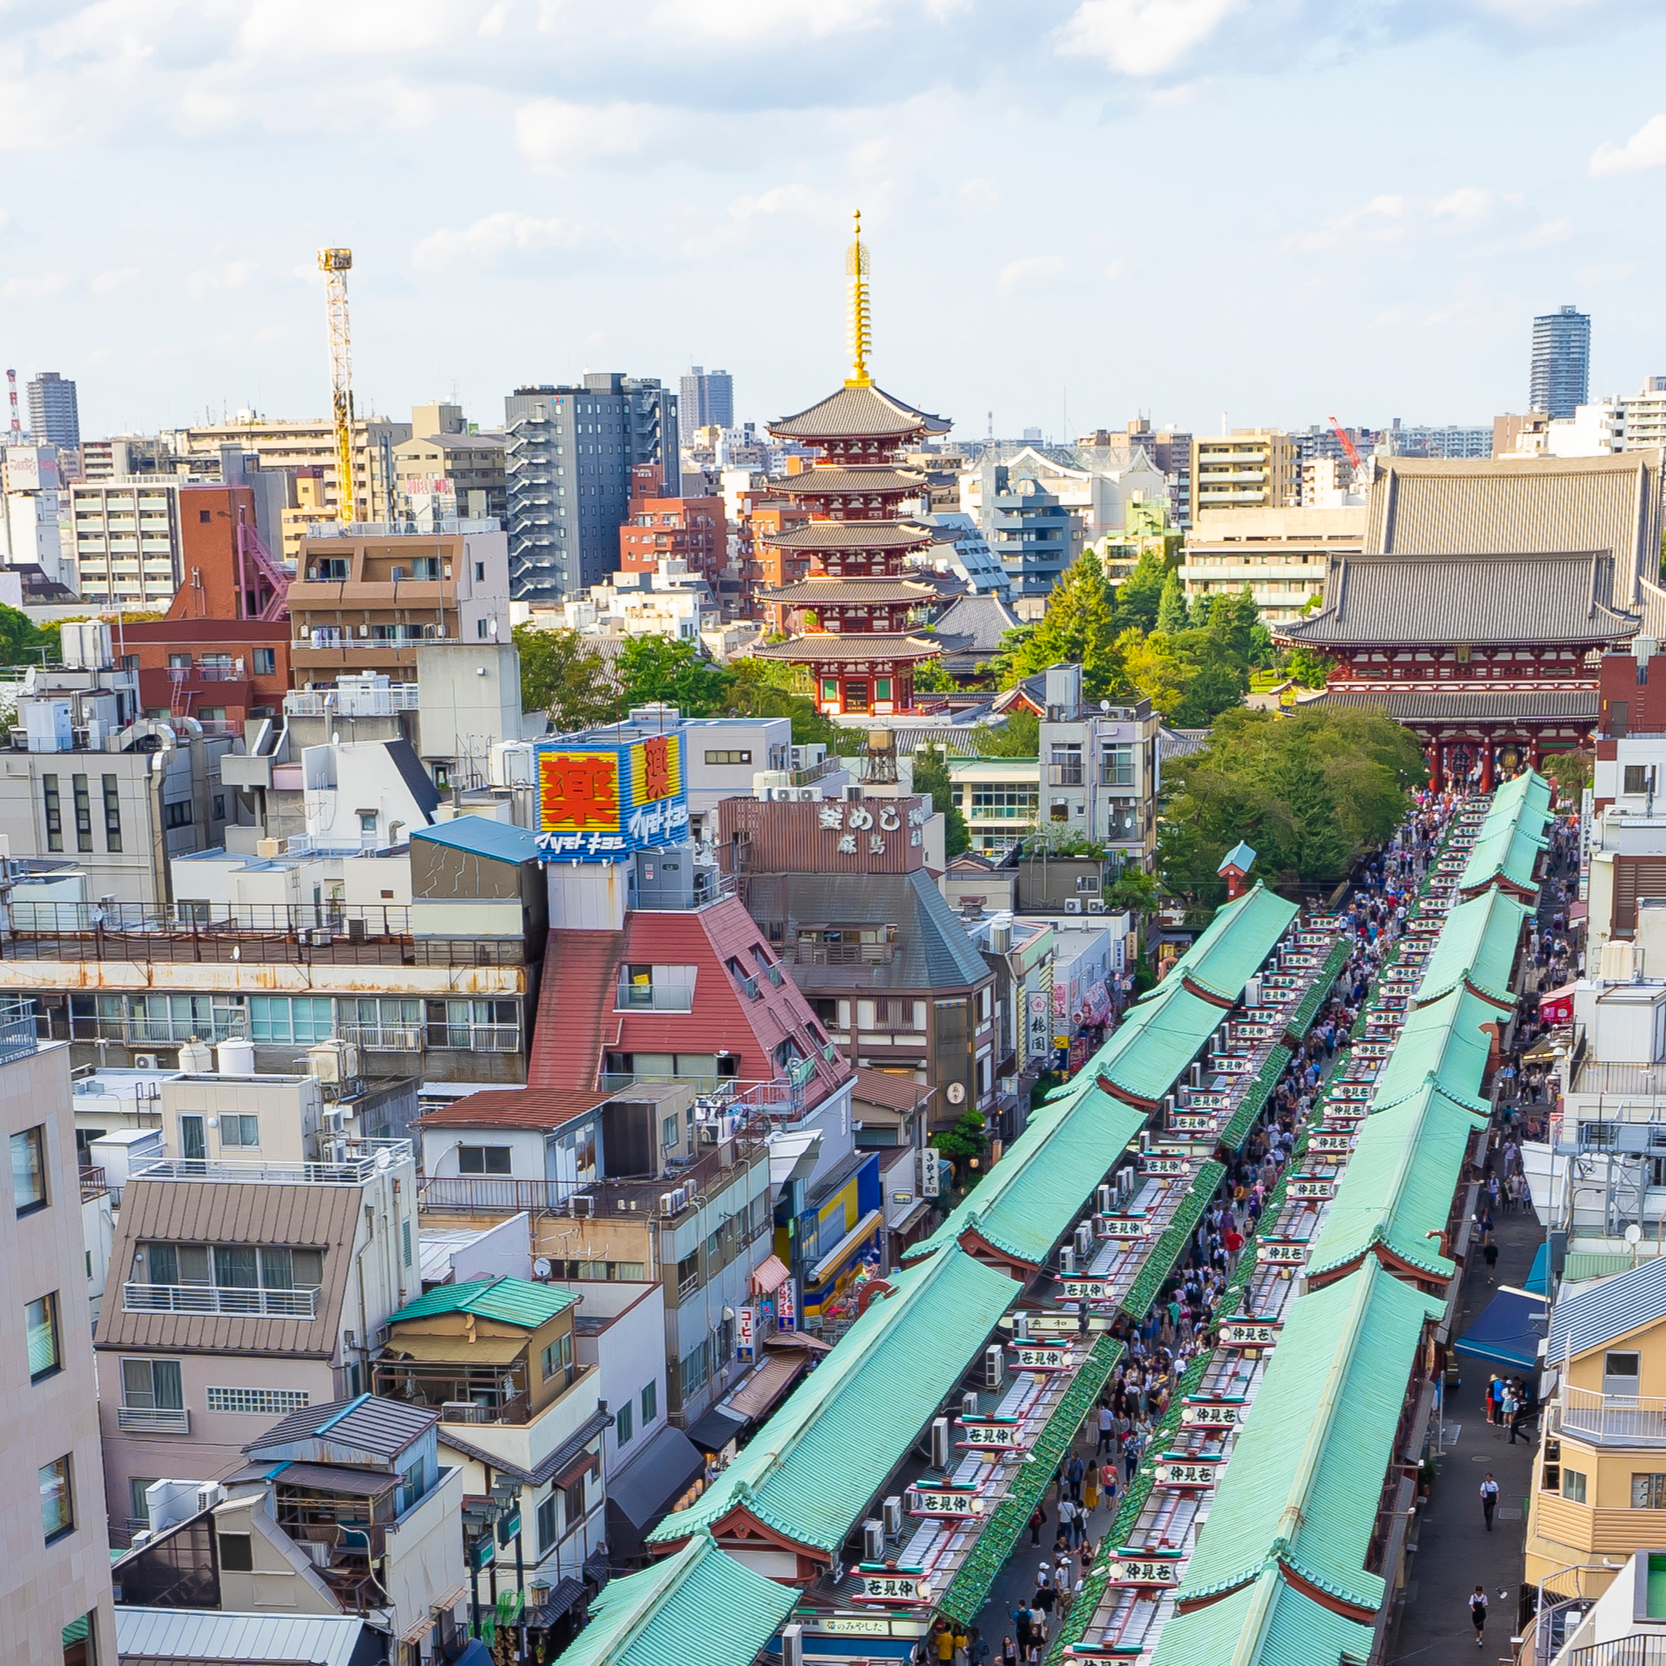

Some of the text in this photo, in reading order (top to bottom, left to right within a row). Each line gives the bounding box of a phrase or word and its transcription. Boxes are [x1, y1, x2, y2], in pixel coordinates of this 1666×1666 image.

[645, 734, 670, 800] 薬
[541, 756, 616, 826] 薬
[817, 805, 902, 832] 釜めし
[535, 832, 627, 855] マツモトキヨシ
[740, 1310, 752, 1345] コーヒー
